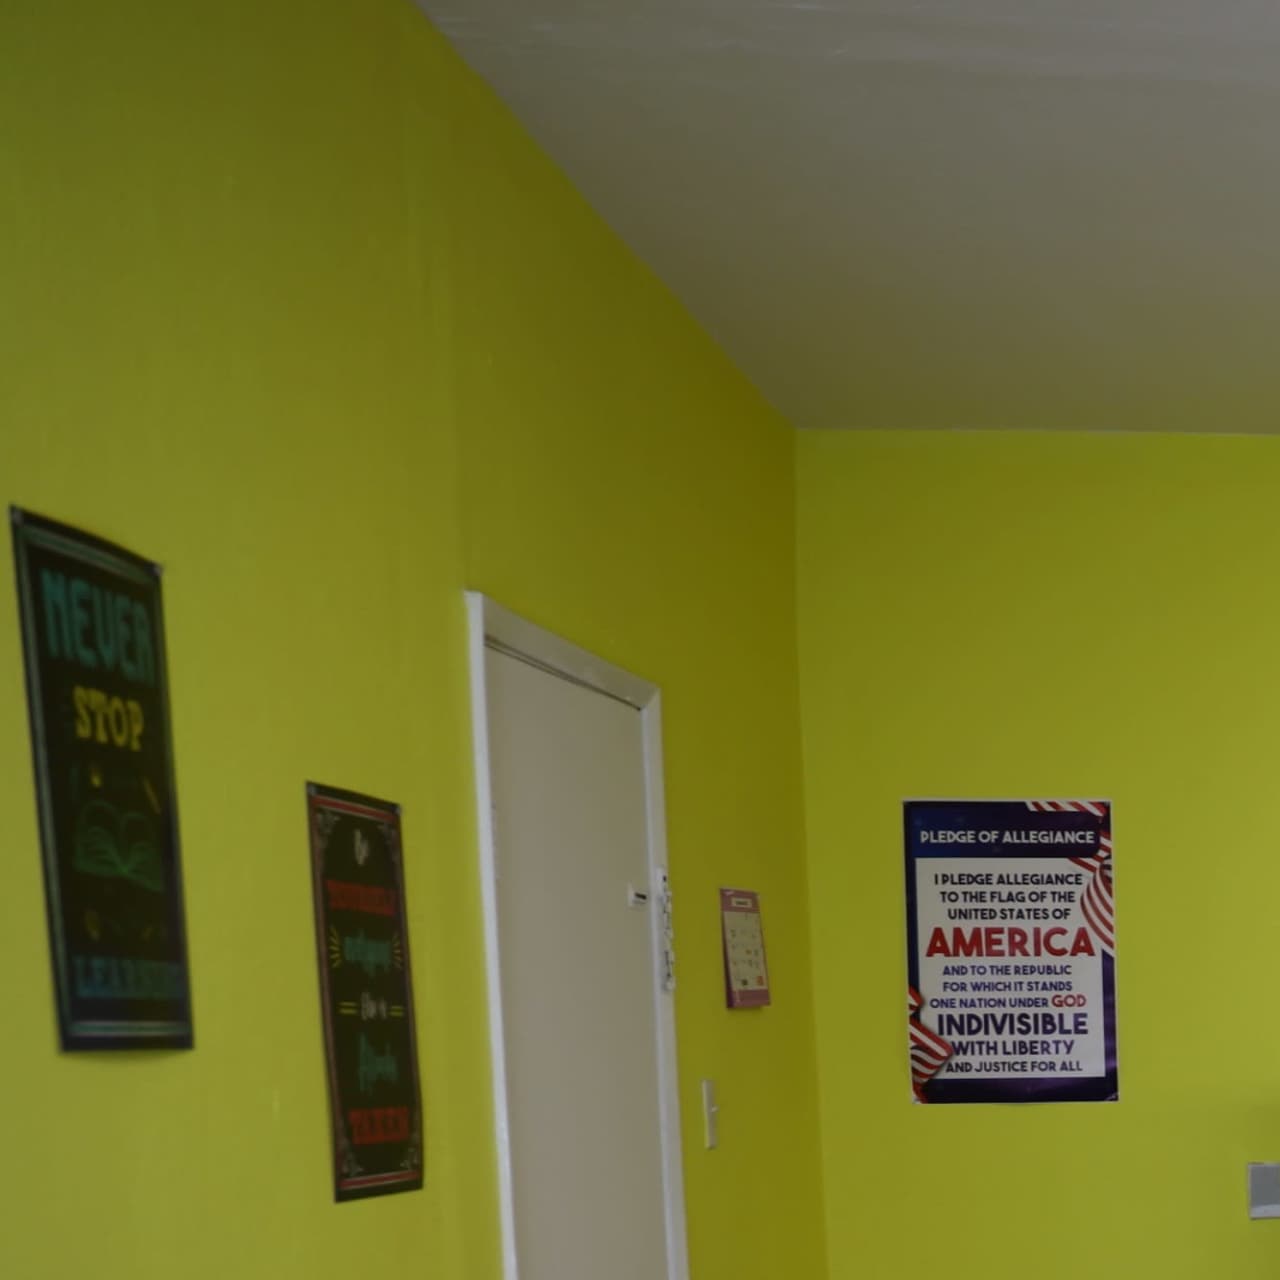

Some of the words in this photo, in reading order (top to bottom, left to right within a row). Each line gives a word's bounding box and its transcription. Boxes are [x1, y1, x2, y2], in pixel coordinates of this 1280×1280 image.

[39, 567, 156, 686] NEVER
[72, 683, 144, 752] STOP
[920, 830, 976, 844] PLEDGE
[978, 830, 999, 844] OF
[1002, 830, 1095, 844] ALLEGIANCE
[934, 873, 938, 885] I
[942, 873, 993, 885] PLEDGE
[996, 873, 1083, 885] ALLEGIANCE
[940, 891, 959, 903] TO
[962, 891, 986, 903] THE
[990, 891, 1025, 903] FLAG
[1028, 891, 1047, 903] OF
[1050, 891, 1075, 903] THE
[947, 908, 997, 920] UNITED
[1000, 908, 1049, 920] STATES
[1052, 908, 1071, 920] OF
[925, 926, 1096, 957] AMERICA
[942, 965, 968, 976] AND
[970, 965, 987, 976] TO
[989, 965, 1011, 976] THE
[1014, 965, 1072, 976] REPUBLIC
[942, 981, 967, 992] FOR
[970, 981, 1011, 992] WHICH
[1014, 981, 1024, 992] IT
[1027, 981, 1072, 992] STANDS
[929, 998, 957, 1009] ONE
[959, 998, 1006, 1009] NATION
[1009, 997, 1048, 1008] UNDER
[1051, 994, 1087, 1008] GOD
[938, 1013, 1088, 1036] INDIVISIBLE
[952, 1040, 999, 1056] WITH
[1002, 1040, 1075, 1056] LIBERTY
[946, 1061, 972, 1073] AND
[974, 1061, 1028, 1073] JUSTICE
[1031, 1061, 1056, 1073] FOR
[1060, 1061, 1083, 1073] ALL
